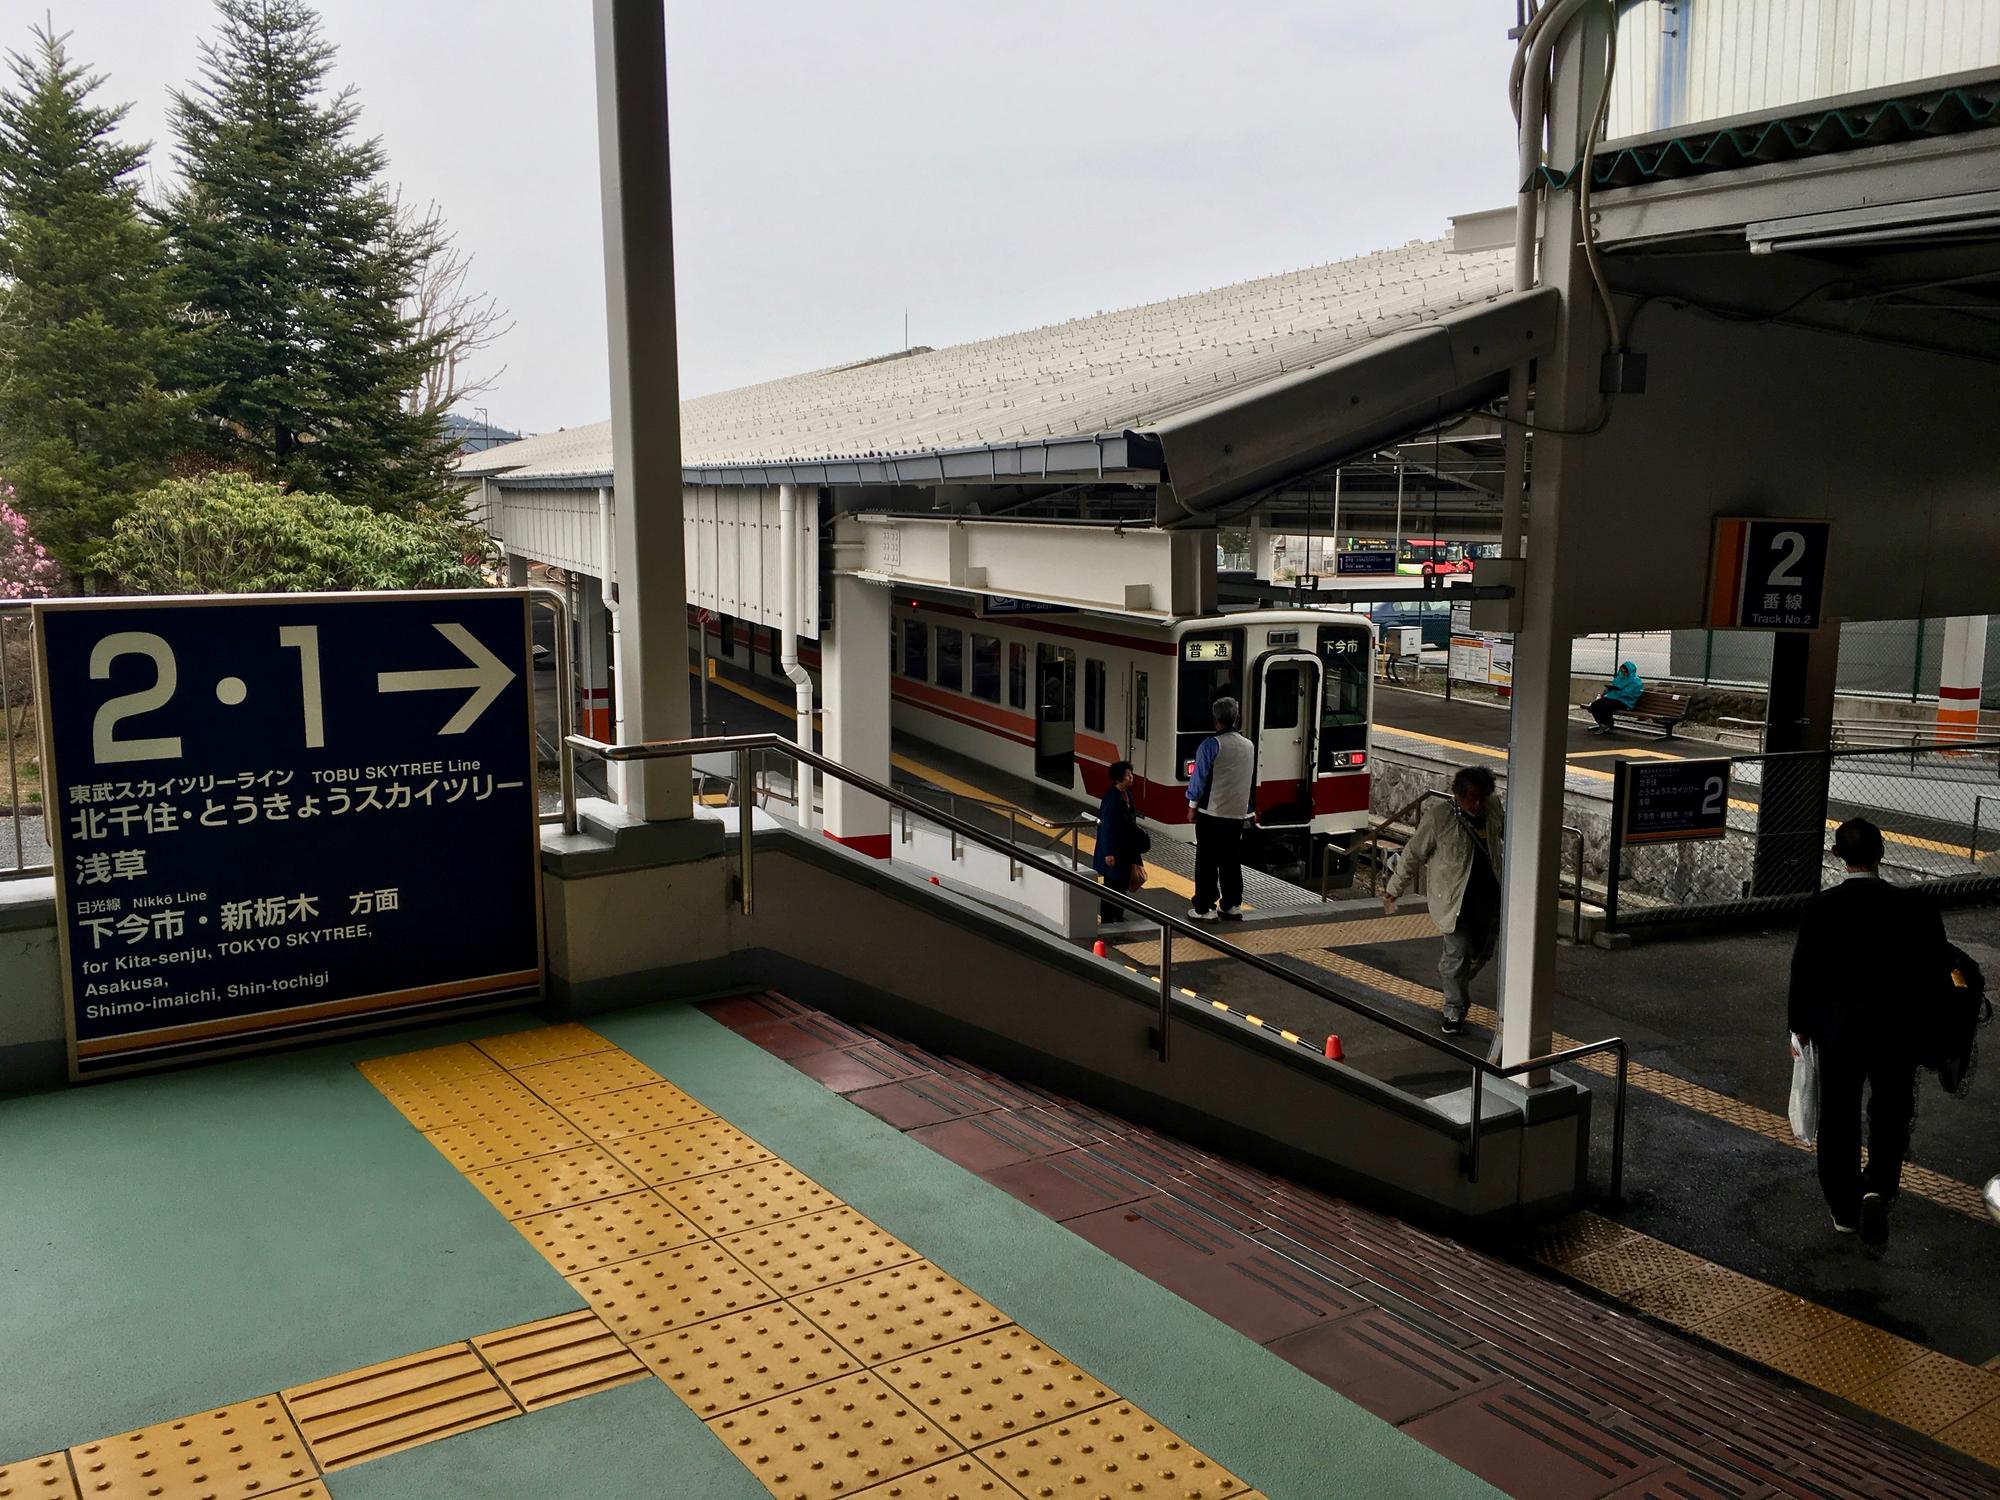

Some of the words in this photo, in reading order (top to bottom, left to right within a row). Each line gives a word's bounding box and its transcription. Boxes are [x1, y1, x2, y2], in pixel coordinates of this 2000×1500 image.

[1767, 531, 1806, 586] 2
[1752, 613, 1782, 624] Track
[1785, 614, 1811, 625] No.2
[1323, 639, 1359, 655] 下今市
[69, 770, 294, 804] 東武スカイツリーライン
[312, 769, 360, 784] TOBU
[365, 761, 443, 779] SKYTREE
[448, 759, 481, 772] Line
[71, 774, 524, 841] 北千住・とうきょうスカイツリー
[1702, 776, 1724, 815] 2
[76, 849, 148, 885] 浅草
[77, 898, 121, 915] 日光線
[133, 894, 173, 909] Nikkō
[177, 891, 207, 904] Line
[79, 893, 320, 949] 下今市・新栃木
[349, 888, 399, 916] 方面
[82, 961, 109, 975] for
[115, 947, 212, 971] Kita-senju,
[218, 936, 280, 956] TOKYO
[286, 924, 373, 947] SKYTREE,
[85, 976, 169, 997] Asakusa,
[86, 988, 221, 1019] Shimo-imaichi,
[227, 971, 329, 999] Shin-tochigi
